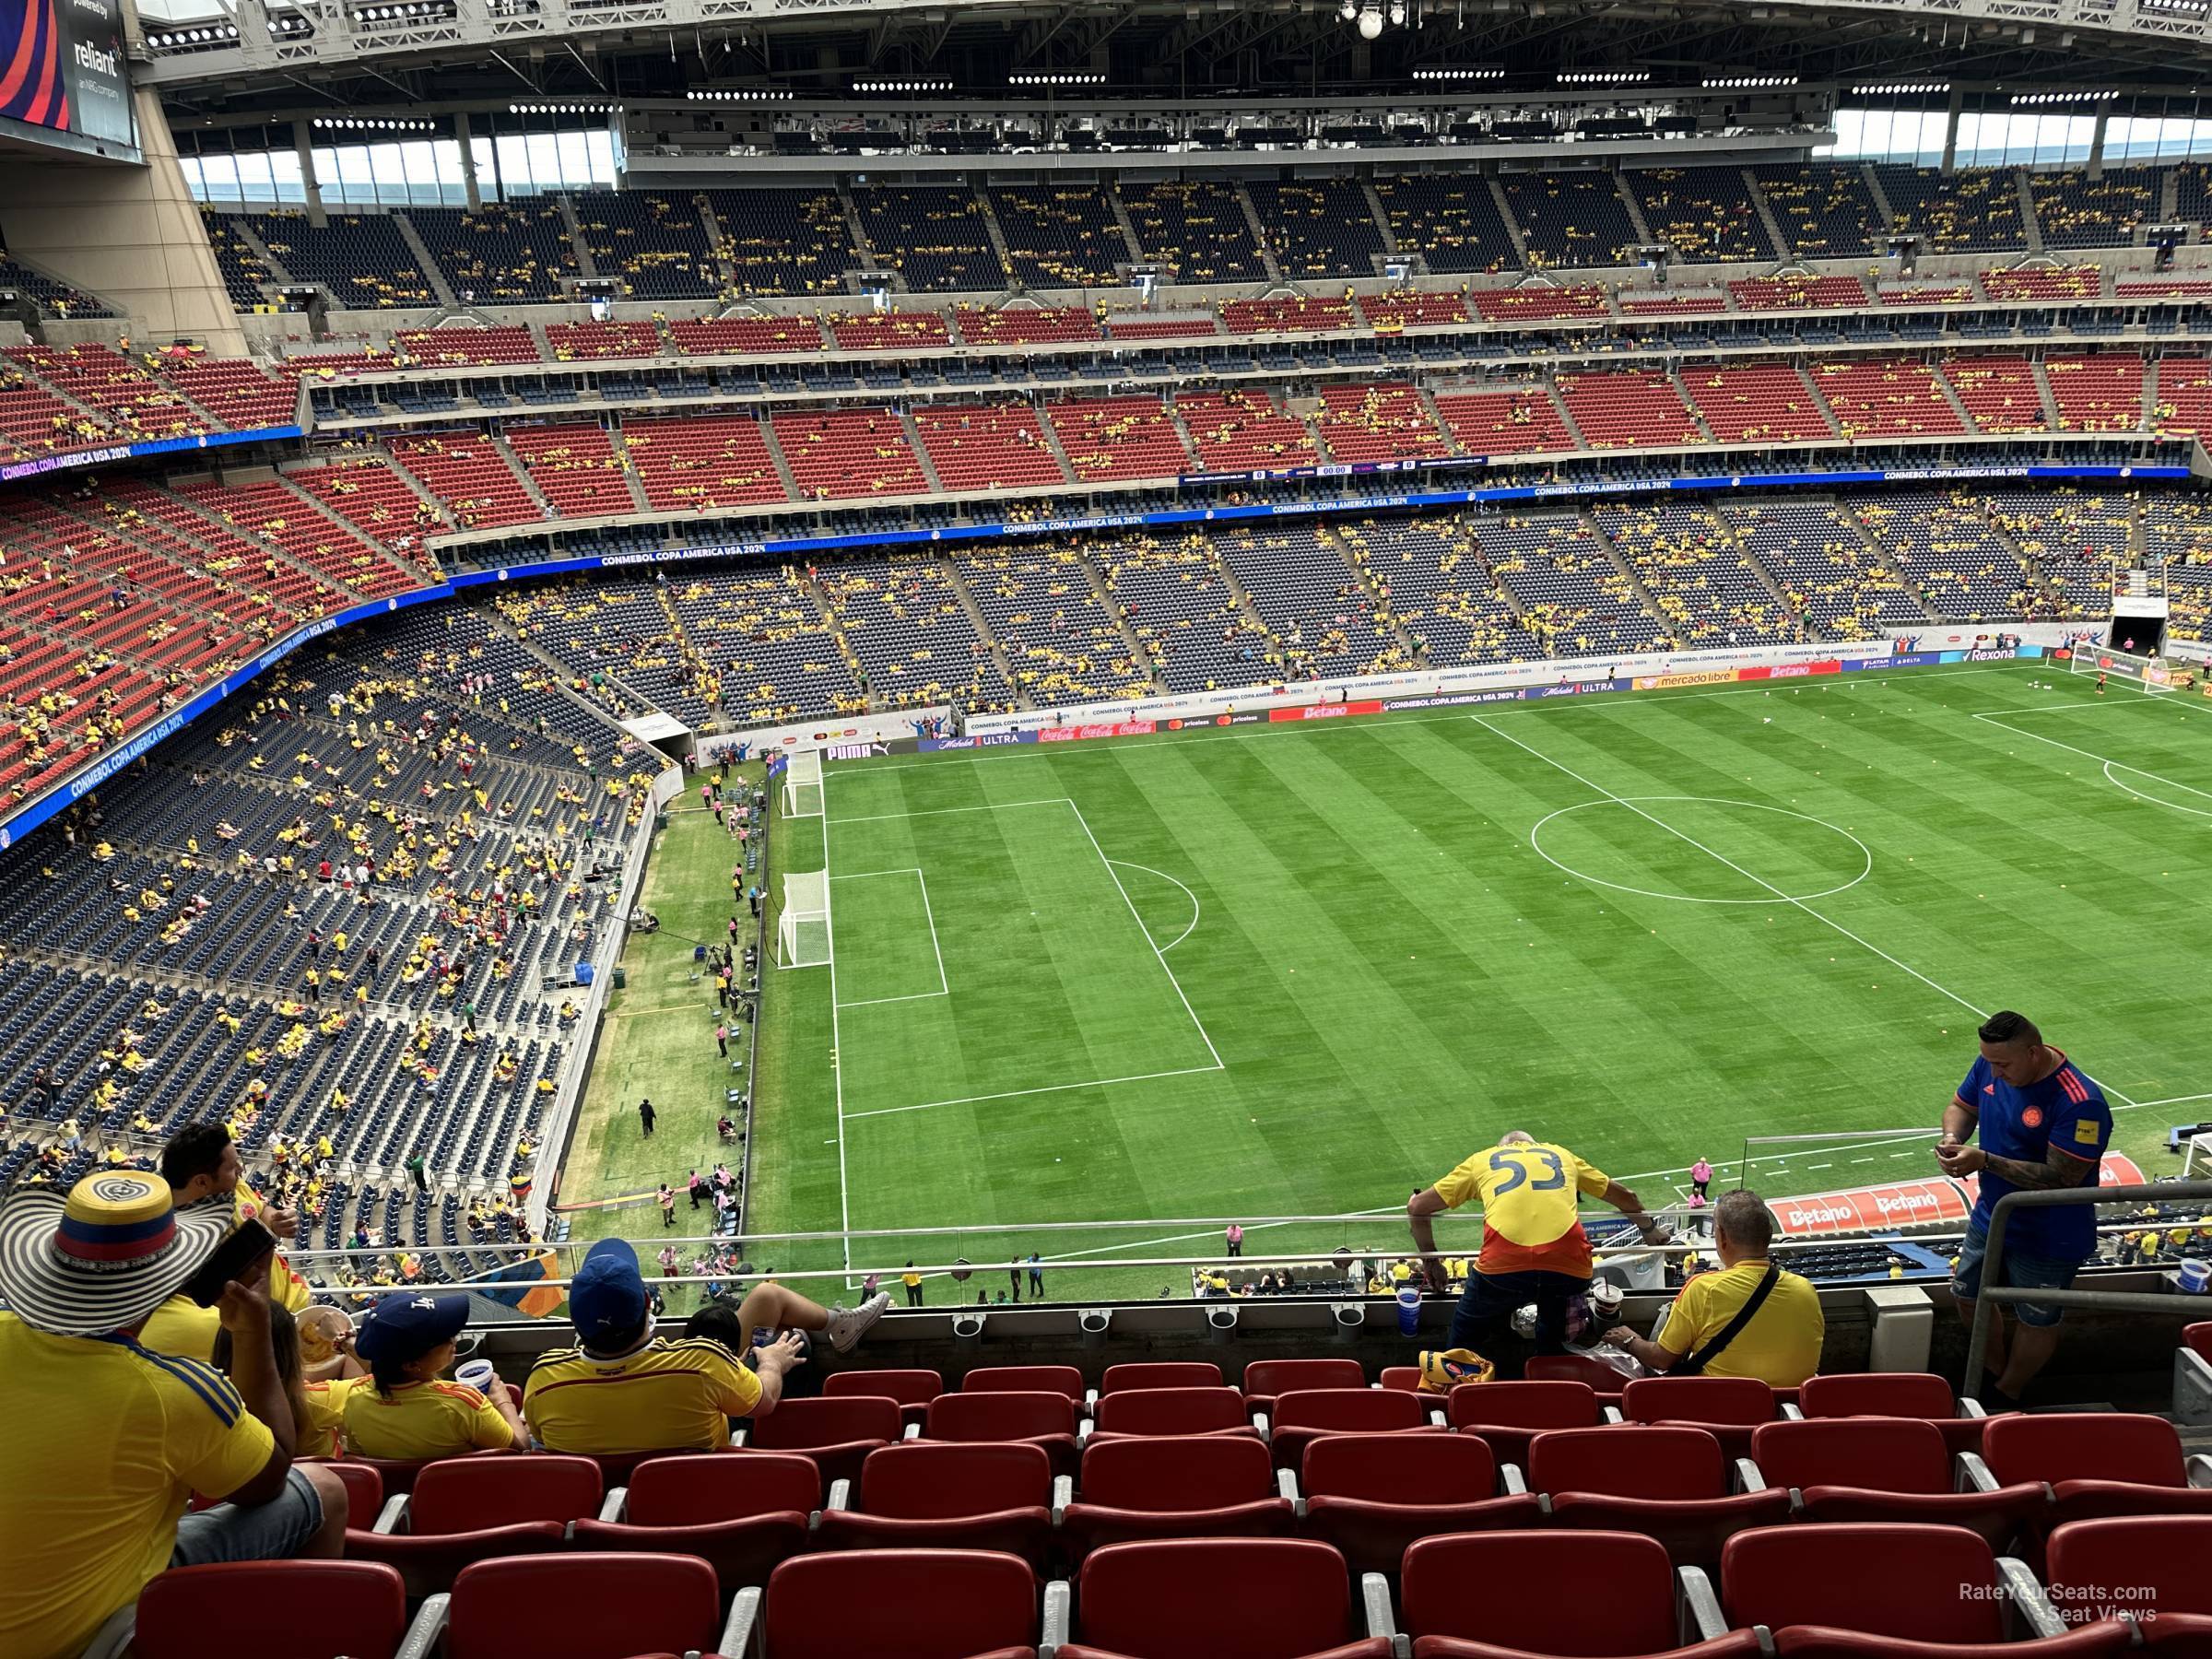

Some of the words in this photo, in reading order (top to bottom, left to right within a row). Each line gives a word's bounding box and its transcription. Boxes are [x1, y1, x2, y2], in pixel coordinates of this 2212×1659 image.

[101, 3, 107, 19] by
[74, 40, 117, 77] reliant
[2, 462, 39, 479] CONMEBOL
[40, 459, 56, 471] COPA
[56, 452, 93, 468] AMERICA
[93, 448, 111, 462] USA
[111, 446, 131, 459] 2024
[1884, 471, 1929, 479] CONMEBOL
[1535, 486, 1578, 496] CONMEBOL
[1579, 485, 1600, 493] COPA
[1600, 483, 1635, 492] AMERICA
[1273, 504, 1315, 513] CONMEBOL
[1317, 502, 1338, 510] COPA
[1338, 499, 1373, 509] AMERICA
[1373, 498, 1388, 506] USA
[1389, 497, 1407, 505] 2024
[1003, 523, 1048, 533] CONMEBOL
[1049, 521, 1071, 530] COPA
[1071, 518, 1107, 528] AMERICA
[1107, 517, 1123, 525] USA
[601, 554, 656, 566] CONMEBOL
[656, 551, 682, 560] COPA
[682, 547, 724, 559] AMERICA
[724, 546, 743, 555] USA
[744, 544, 765, 554] 2024
[308, 624, 322, 636] USA
[321, 618, 337, 632] 2024
[1972, 649, 2015, 661] Rexona
[1661, 674, 1706, 686] mercado
[1708, 672, 1730, 682] libre
[1771, 666, 1809, 678] Betano
[1582, 682, 1614, 692] ULTRA
[1210, 694, 1239, 702] CONMEBOL
[1390, 699, 1429, 709] CONMEBOL
[1450, 695, 1482, 704] AMERICA
[1093, 706, 1123, 715] CONMEBOL
[1304, 706, 1347, 718] Betano
[971, 721, 1002, 729] CONMEBOL
[1019, 716, 1044, 724] AMERICA
[1119, 721, 1152, 735] Coca-Cola
[1042, 728, 1074, 741] Coca-Cola
[1080, 725, 1113, 737] Coca-Cola
[983, 735, 1019, 745] ULTRA
[72, 761, 112, 797] CONMEBOL
[111, 747, 131, 770] COPA
[130, 730, 159, 756] AMERICA
[157, 723, 170, 737] USA
[168, 714, 184, 731] 2024
[827, 745, 871, 760] PUMA
[1490, 1149, 1565, 1196] 53
[1875, 1194, 1938, 1212] Betano
[1789, 1206, 1851, 1227] Betano
